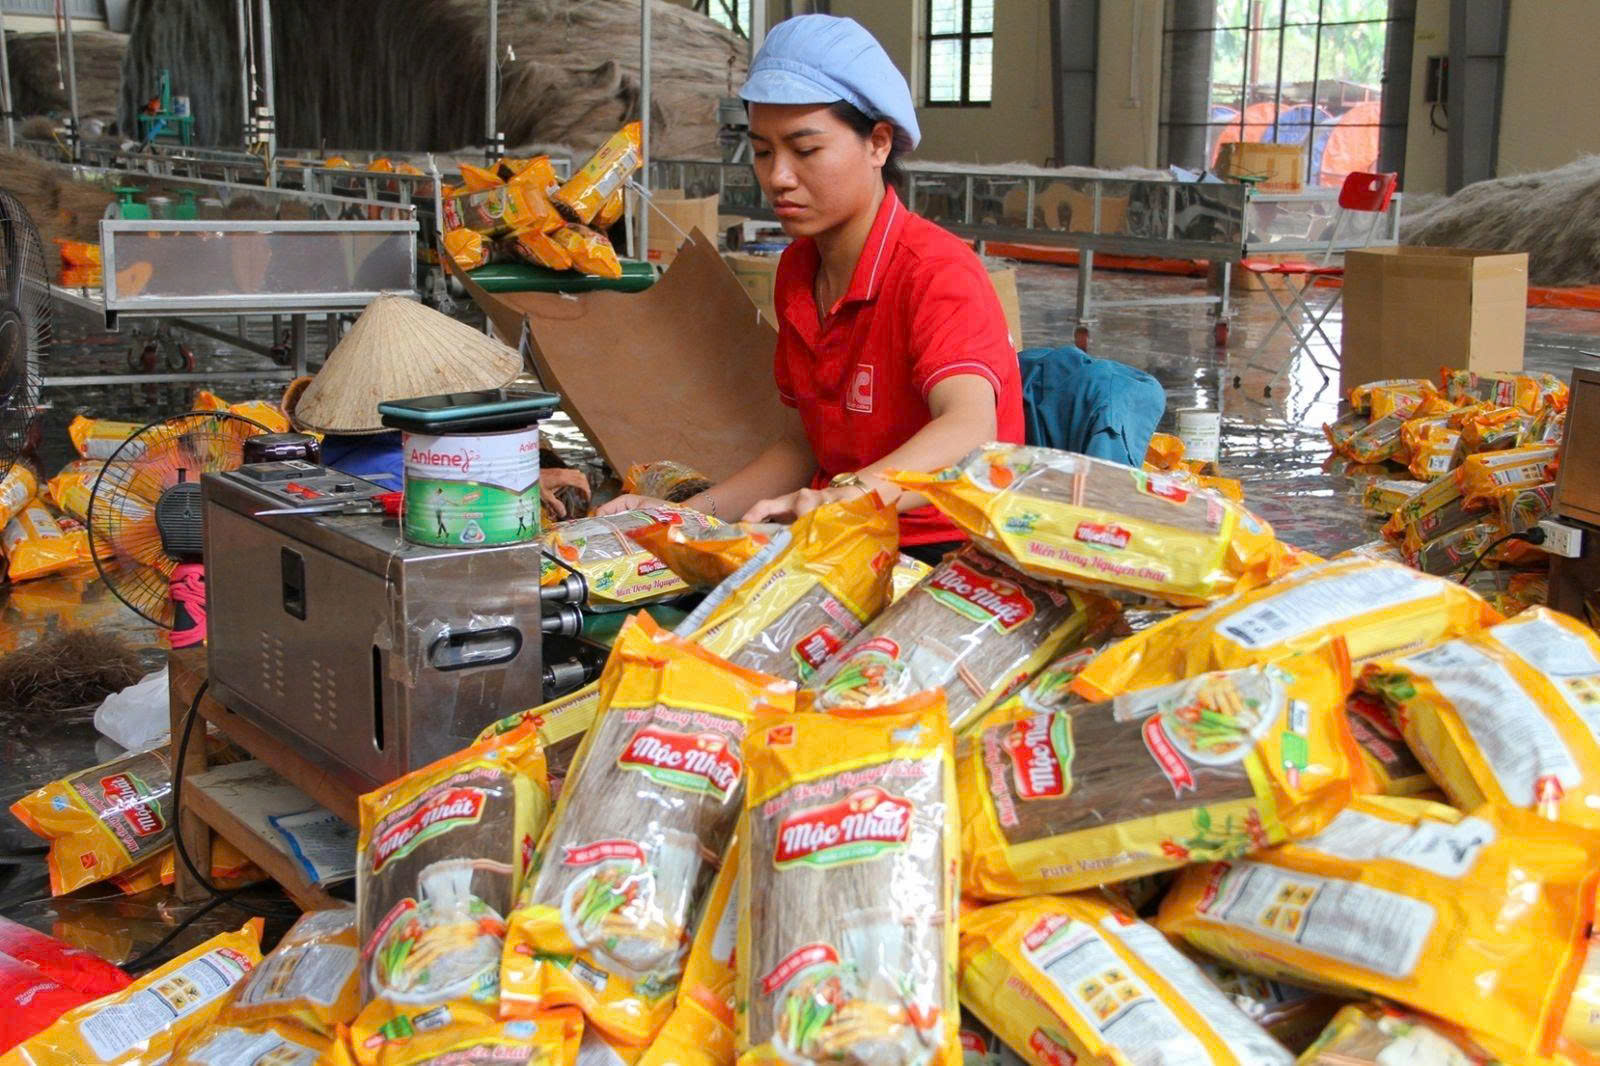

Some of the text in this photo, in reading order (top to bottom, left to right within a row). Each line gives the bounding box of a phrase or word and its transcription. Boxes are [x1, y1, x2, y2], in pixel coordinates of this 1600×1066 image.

[411, 447, 463, 467] Anlene
[631, 735, 682, 766] Mộc
[683, 748, 738, 789] Nhất
[1028, 743, 1056, 793] Mộc
[782, 820, 840, 853] Mộc
